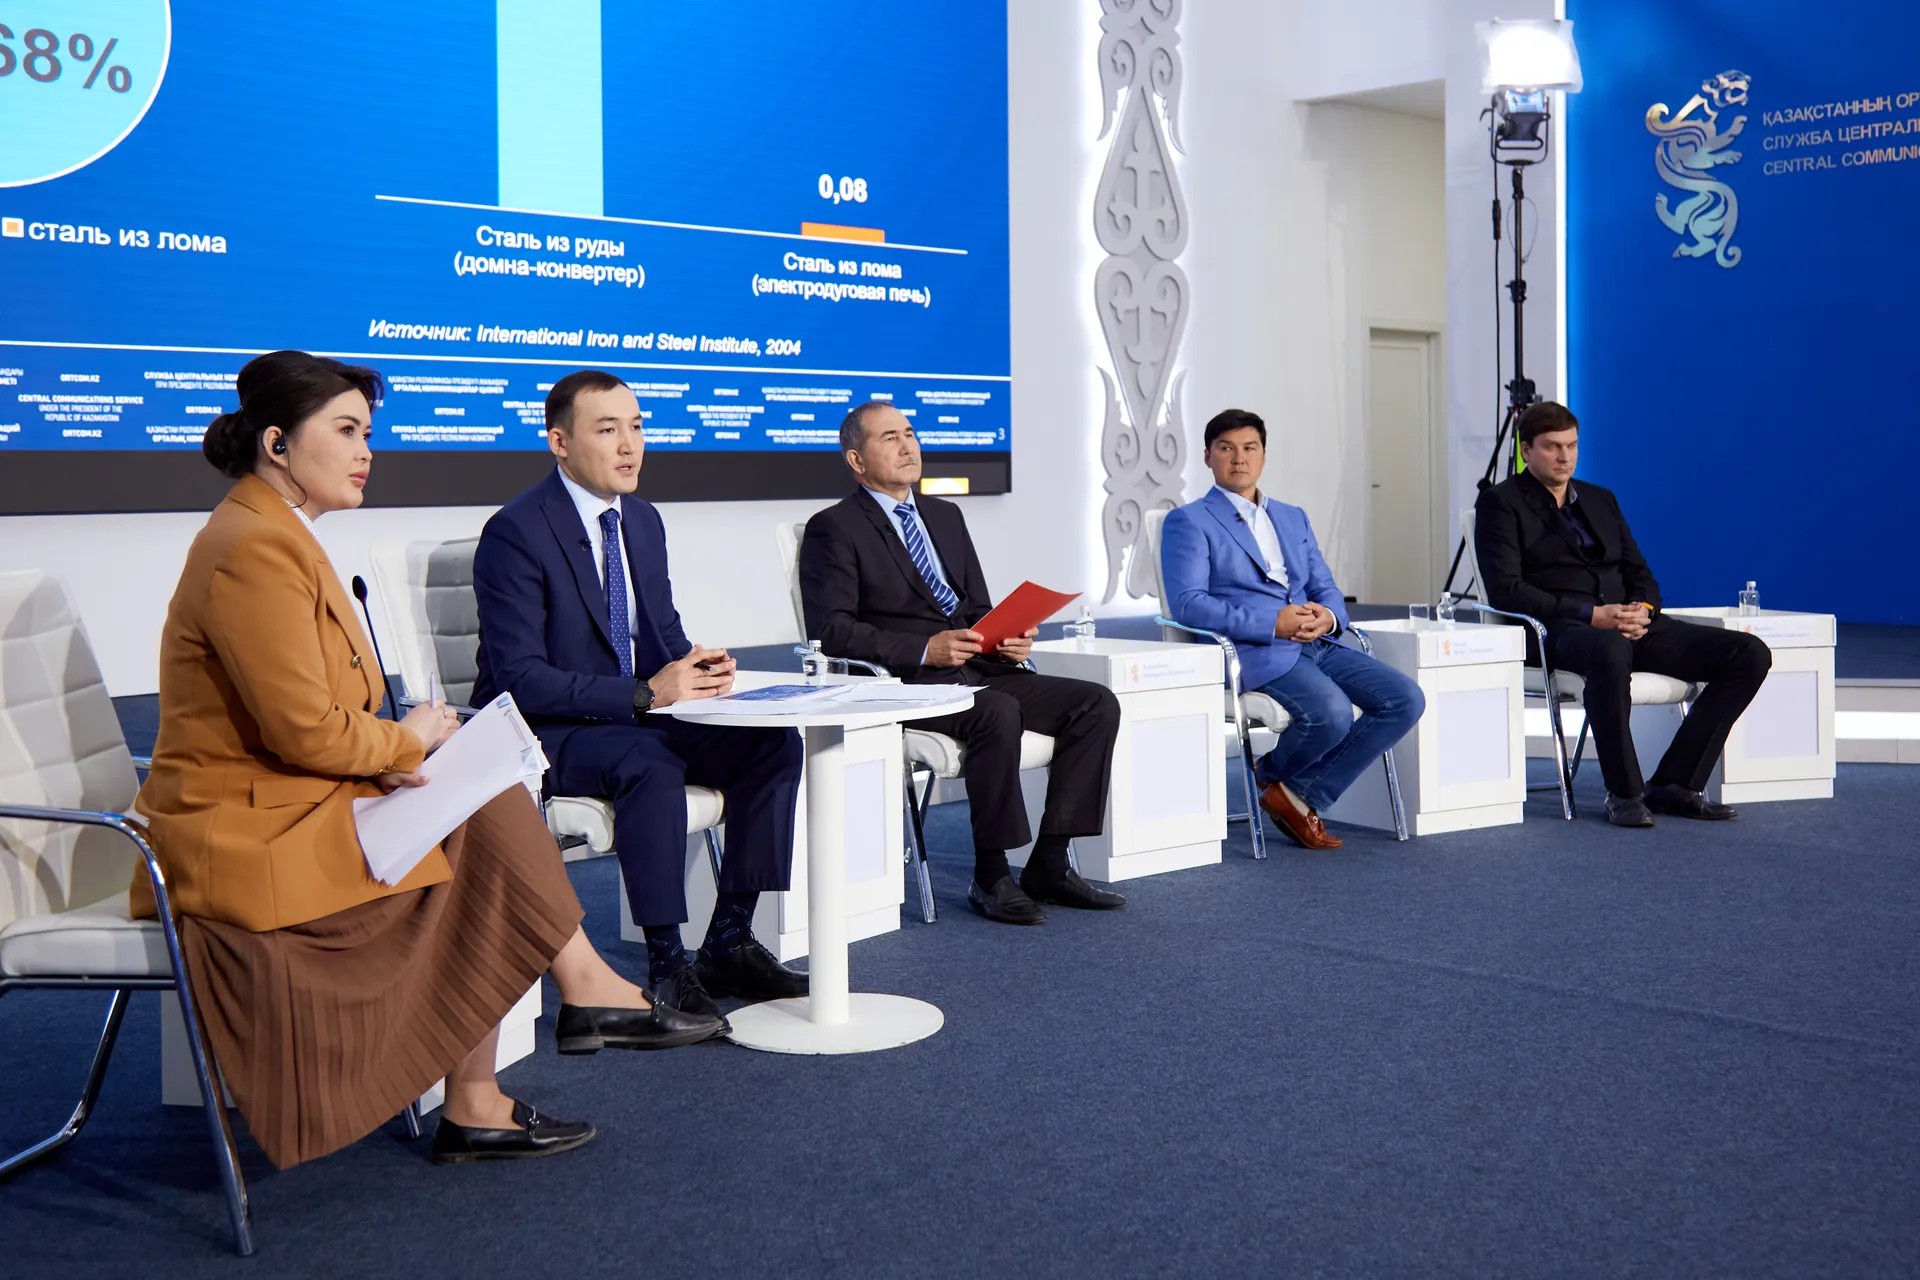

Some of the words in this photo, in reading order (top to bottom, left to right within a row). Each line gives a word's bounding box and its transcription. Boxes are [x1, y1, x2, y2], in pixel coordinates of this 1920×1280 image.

[1763, 95, 1892, 127] ҚАЗАҚСТАННЫҢ
[1896, 92, 1920, 108] ОР
[1763, 129, 1833, 151] СЛУЖБА
[1763, 154, 1837, 176] CENTRAL
[818, 174, 868, 204] 0,08
[28, 222, 111, 245] сталь
[119, 229, 150, 247] из
[157, 232, 227, 253] лома
[476, 226, 542, 249] Сталь
[547, 235, 570, 252] из
[575, 238, 625, 258] руды
[454, 251, 646, 288] (домна-конвертер)
[783, 252, 836, 273] Сталь
[838, 260, 858, 275] из
[860, 262, 902, 278] лома
[752, 274, 887, 302] (электродуговая
[889, 287, 931, 308] печь)
[368, 319, 472, 341] Источник:
[476, 325, 583, 346] International
[586, 330, 619, 347] Iron
[622, 333, 654, 349] and
[656, 333, 698, 351] Steel
[699, 336, 761, 356] Institute,
[765, 339, 802, 355] 2004
[998, 427, 1006, 441] 3
